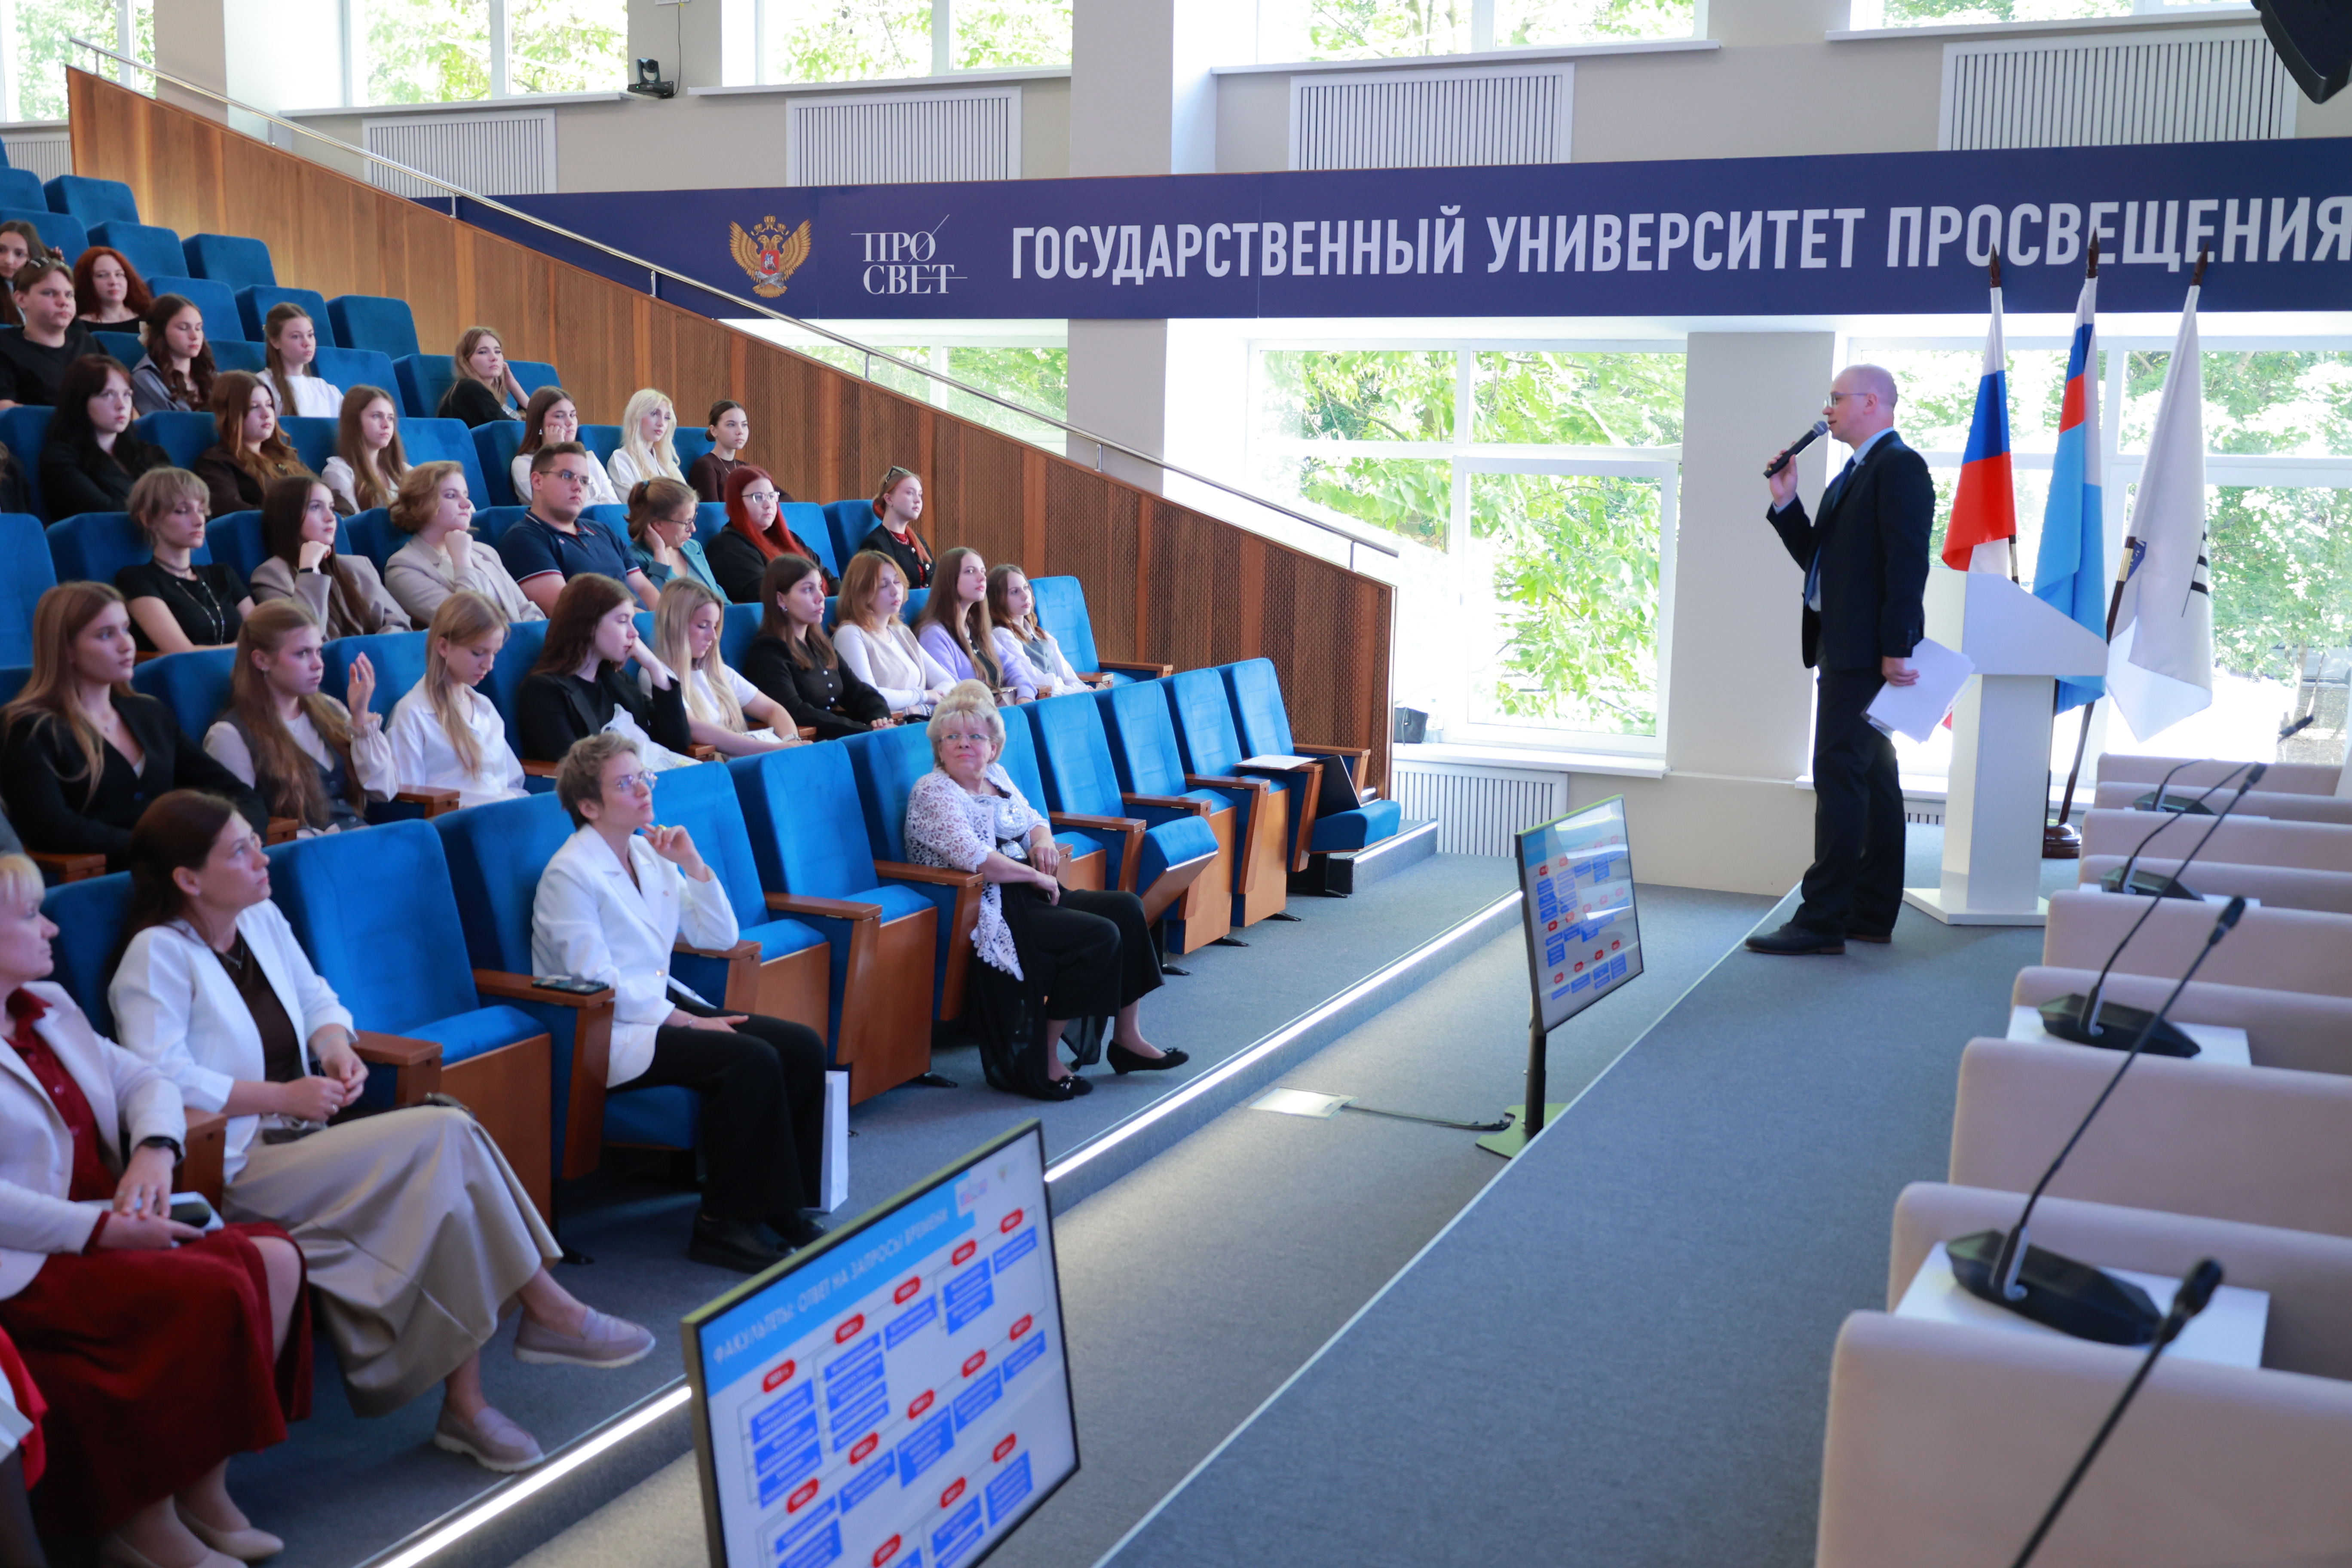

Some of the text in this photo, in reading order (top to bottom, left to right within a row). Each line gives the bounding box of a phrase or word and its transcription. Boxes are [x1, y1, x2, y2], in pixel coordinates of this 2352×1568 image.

[851, 221, 943, 263] ПРО
[1013, 196, 2352, 285] ГОСУДАРСТВЕННЫЙ УНИВЕРСИТЕТ ПРОСВЕЩЕНИЯ
[863, 264, 966, 294] СВЕТ
